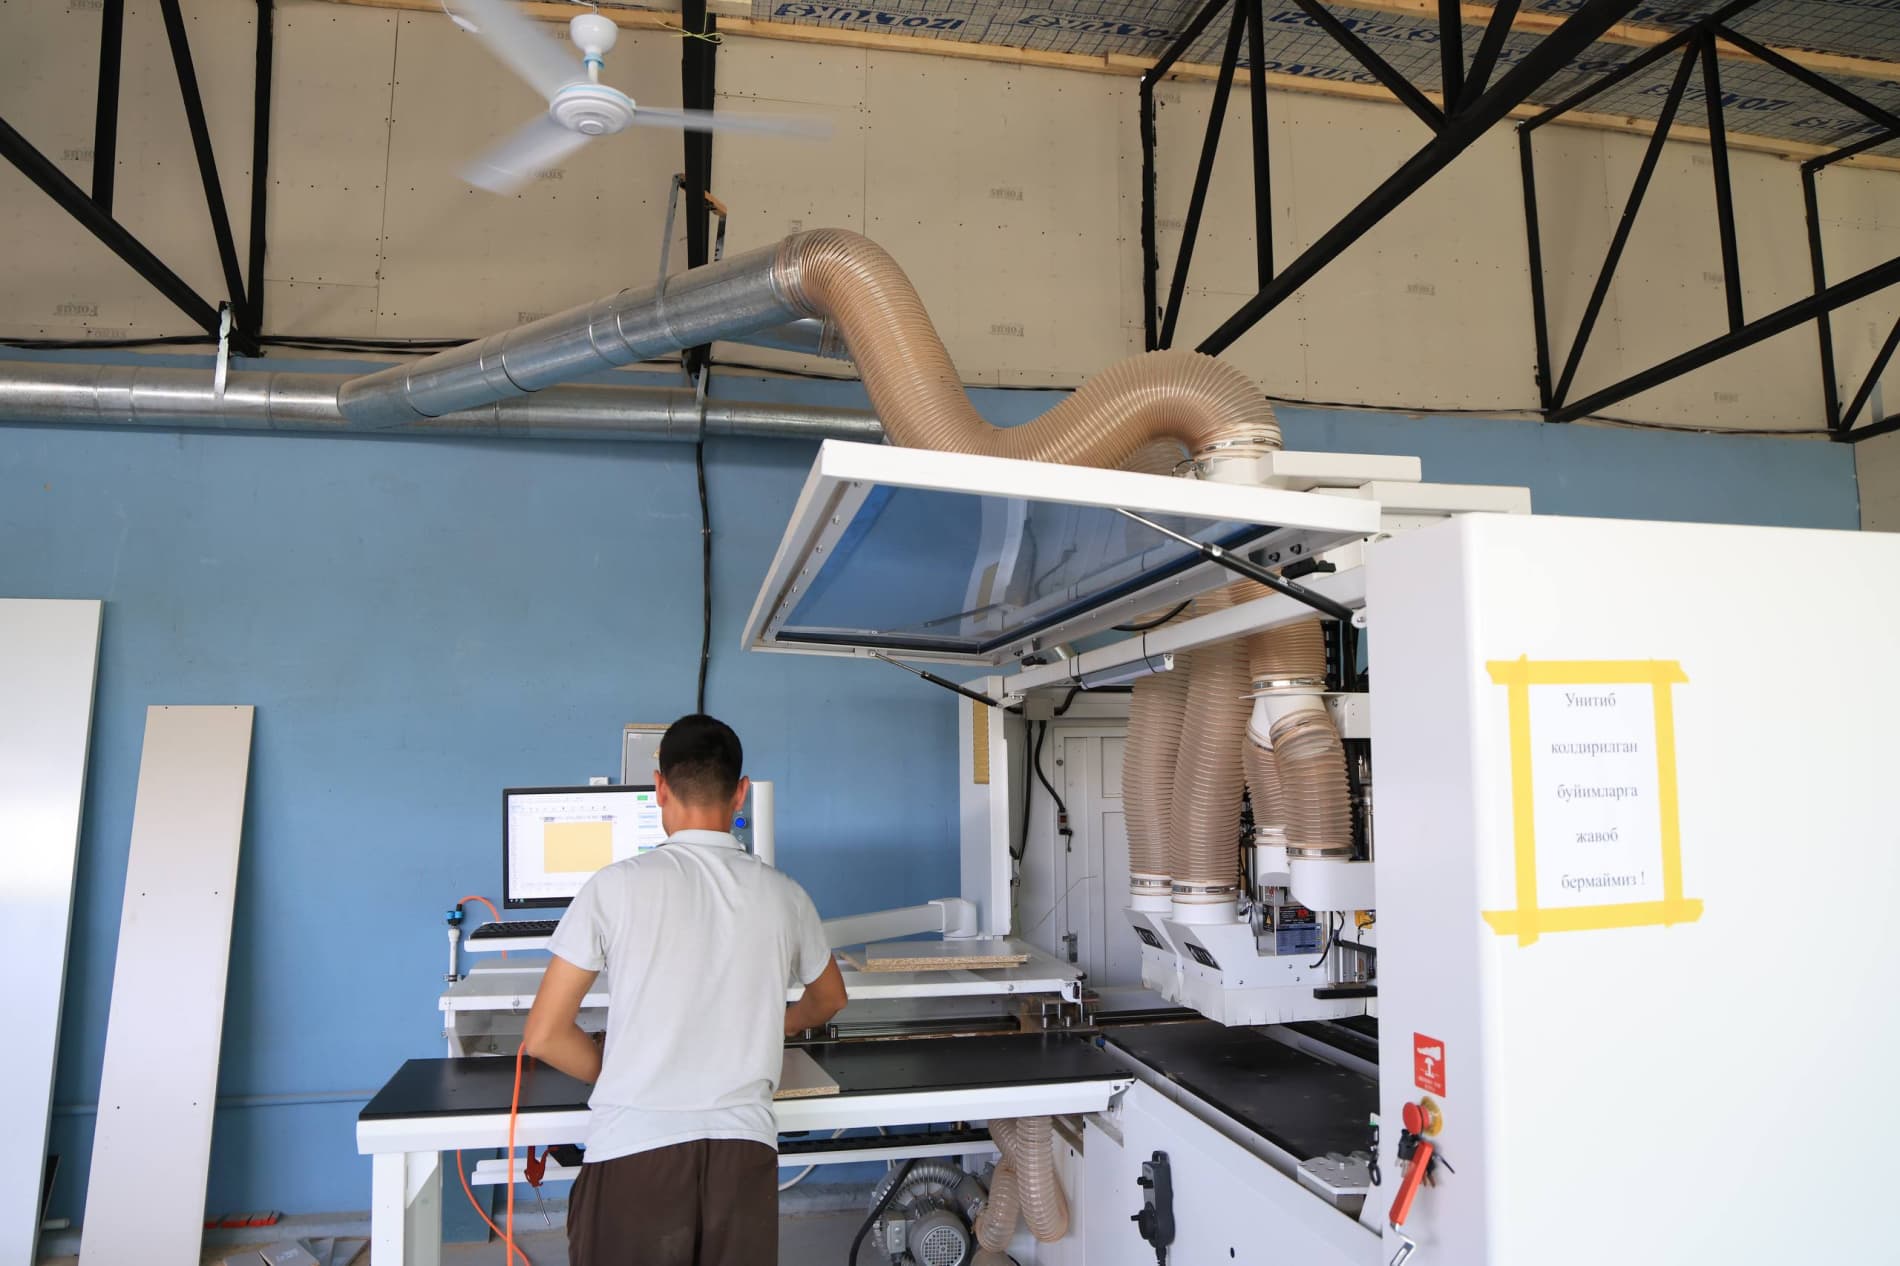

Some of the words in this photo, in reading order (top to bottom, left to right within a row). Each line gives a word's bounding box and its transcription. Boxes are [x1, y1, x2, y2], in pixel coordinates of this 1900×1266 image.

[1565, 692, 1617, 708] Унитиб
[1551, 741, 1638, 757] колдирилган
[1557, 784, 1639, 803] буйимларга
[1576, 827, 1619, 844] жавоб
[1561, 871, 1637, 892] бермаймиз
